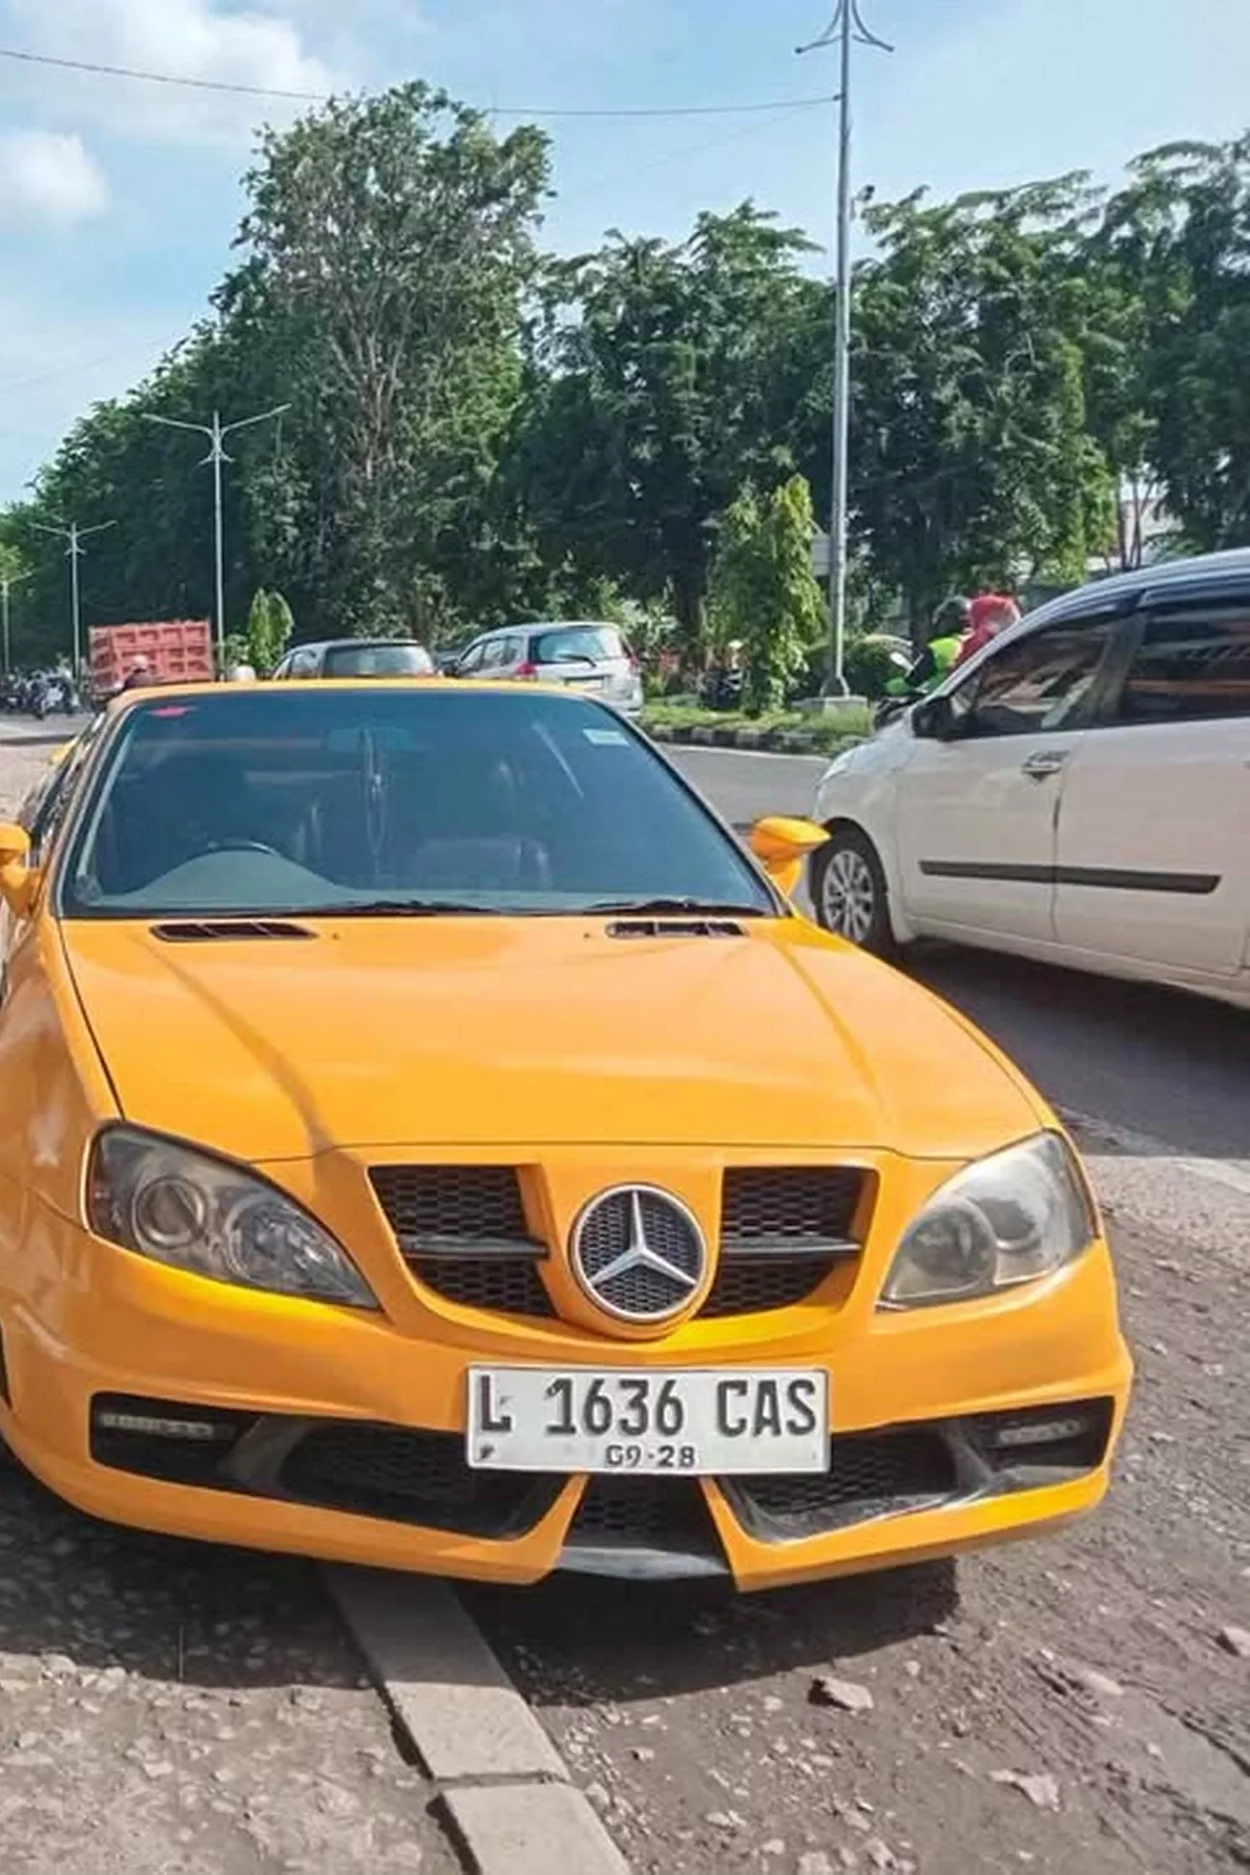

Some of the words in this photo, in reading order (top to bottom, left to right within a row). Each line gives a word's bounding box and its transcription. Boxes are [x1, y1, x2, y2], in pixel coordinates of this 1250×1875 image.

[480, 1375, 512, 1432] L
[545, 1378, 685, 1437] 1636
[717, 1379, 817, 1438] CAS
